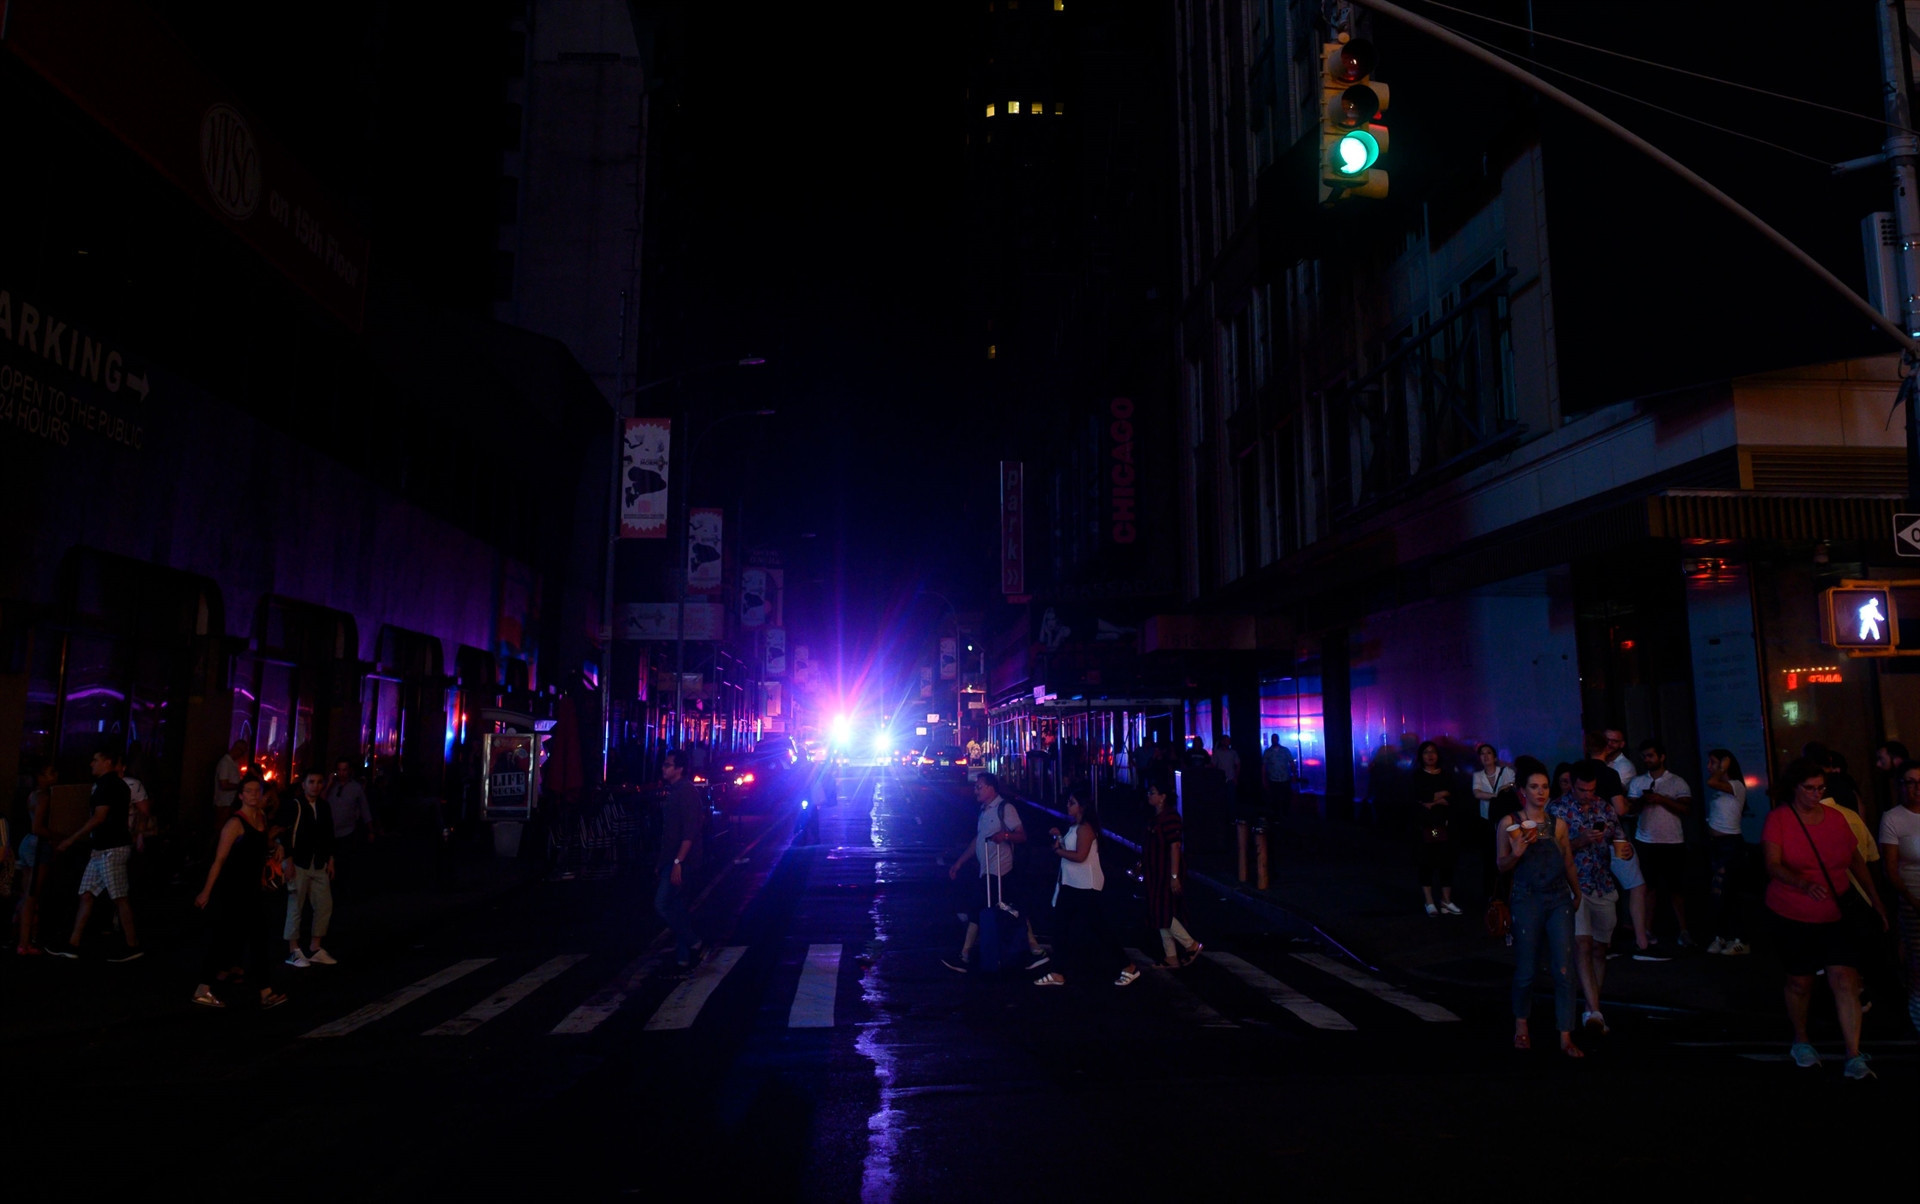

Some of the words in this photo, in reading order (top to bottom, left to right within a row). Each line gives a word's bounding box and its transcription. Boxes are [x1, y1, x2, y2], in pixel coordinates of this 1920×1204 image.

[269, 188, 290, 229] on
[295, 204, 323, 260] 15th
[325, 231, 359, 288] Floor
[0, 288, 124, 393] ARKING
[0, 363, 44, 409] OPEN
[47, 384, 66, 417] TO
[69, 395, 96, 432] THE
[98, 409, 144, 451] PUBLIC
[16, 402, 70, 448] HOURS
[1110, 397, 1137, 544] CHICAGO
[493, 773, 524, 786] LIFE
[493, 786, 522, 795] SUCKS
